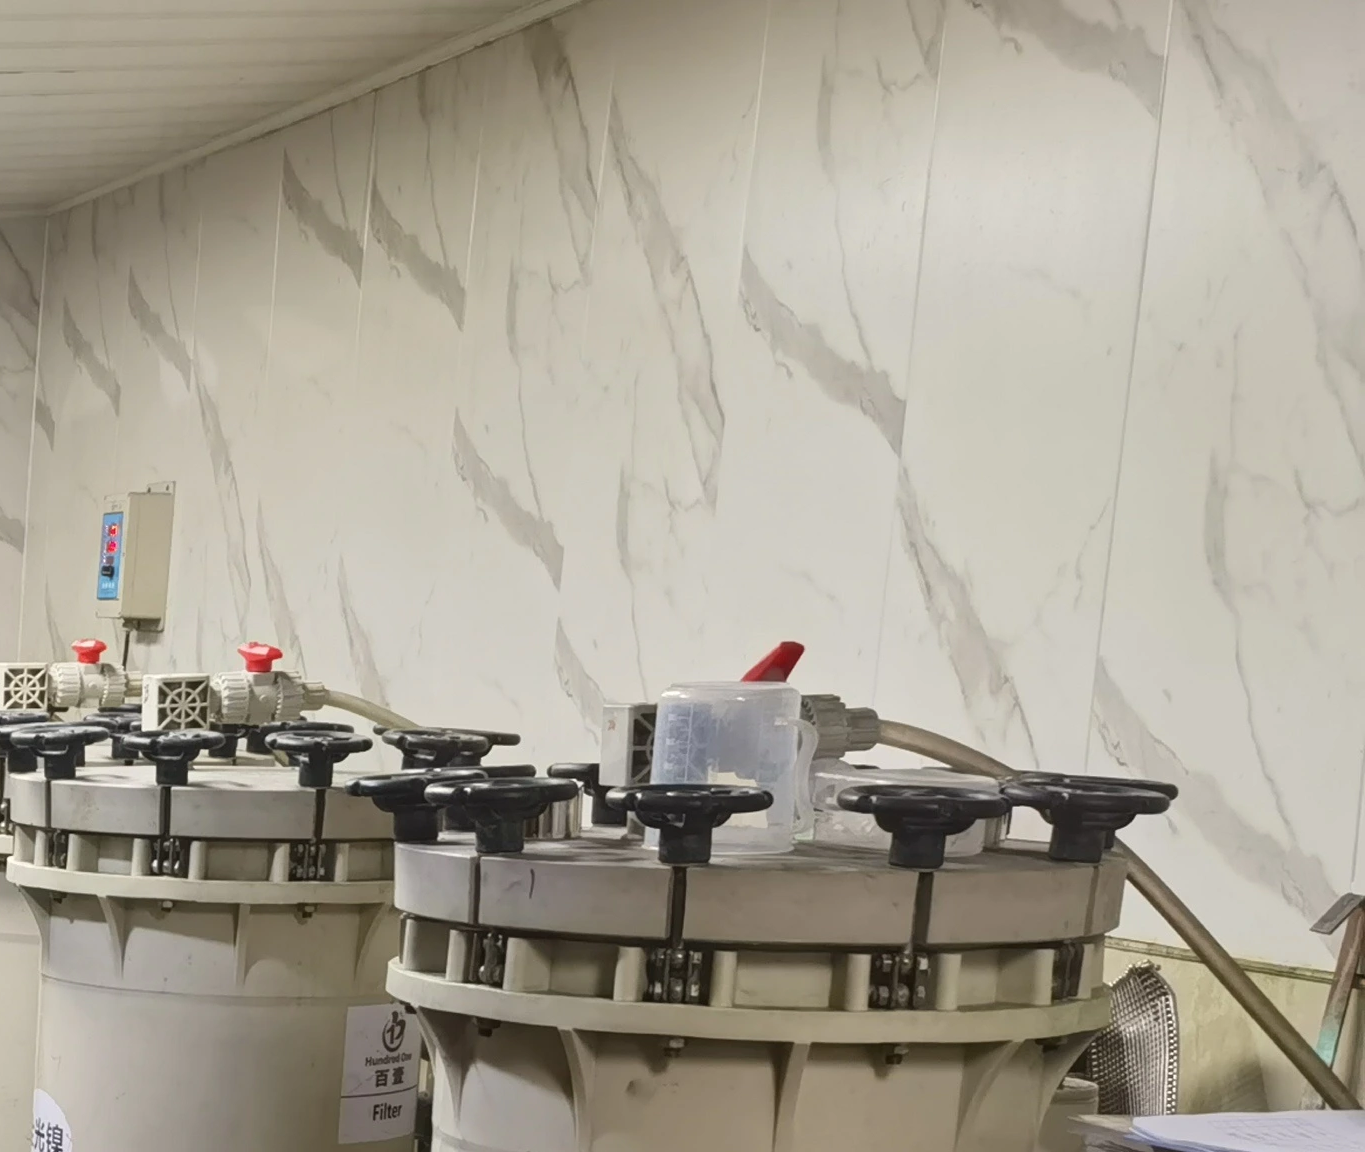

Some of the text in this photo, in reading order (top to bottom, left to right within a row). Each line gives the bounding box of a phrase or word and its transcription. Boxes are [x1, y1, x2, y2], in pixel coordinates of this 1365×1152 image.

[365, 1053, 400, 1067] Hundred
[375, 1066, 405, 1088] 百壹
[372, 1102, 403, 1121] Filter
